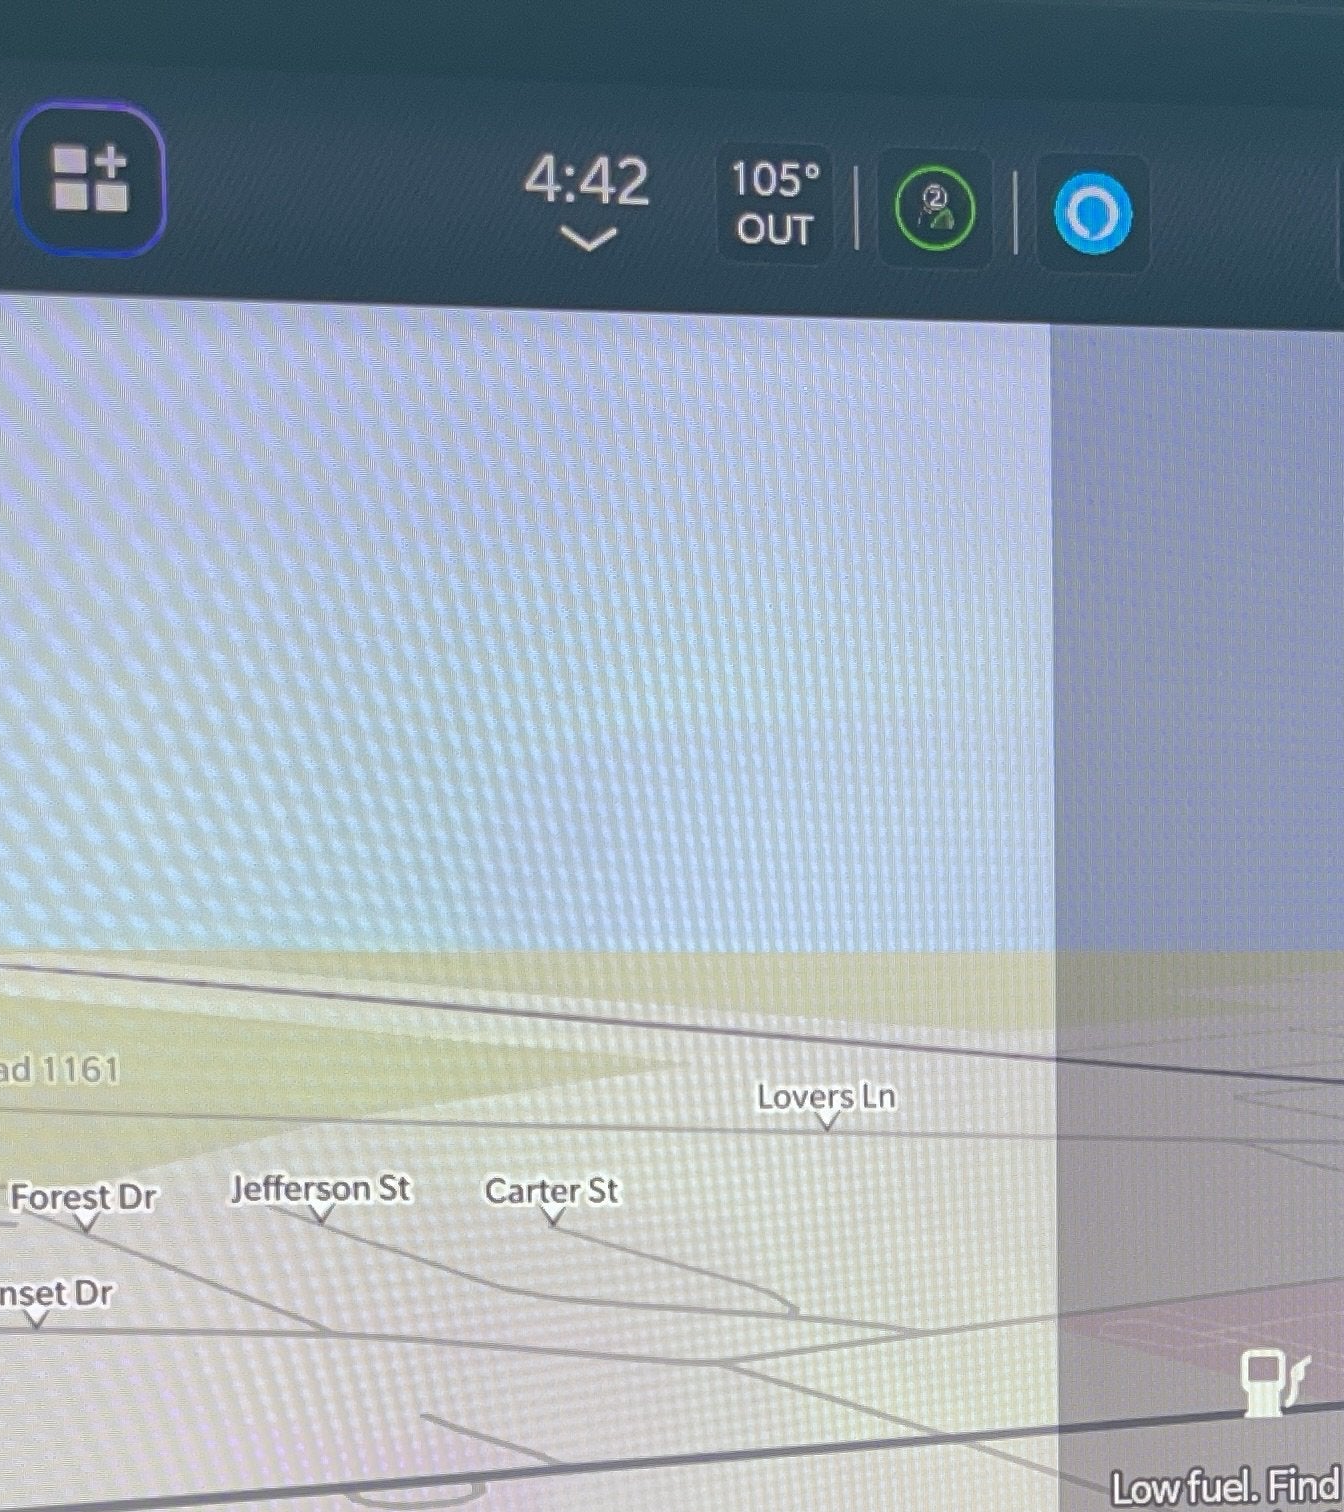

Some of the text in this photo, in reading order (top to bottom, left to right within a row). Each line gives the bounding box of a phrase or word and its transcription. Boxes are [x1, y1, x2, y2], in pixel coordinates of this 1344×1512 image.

[524, 153, 650, 206] 4:42
[732, 160, 821, 198] 105°
[737, 212, 816, 246] OUT
[43, 1055, 118, 1083] 1161
[757, 1083, 896, 1110] Lovers Ln
[10, 1183, 157, 1211] Forest Dr
[231, 1174, 411, 1204] Jefferson St
[485, 1177, 619, 1204] Carter St
[75, 1280, 113, 1307] Dr
[1112, 1471, 1181, 1505] Low
[1186, 1467, 1260, 1504] fuel.
[1268, 1465, 1341, 1502] Find
